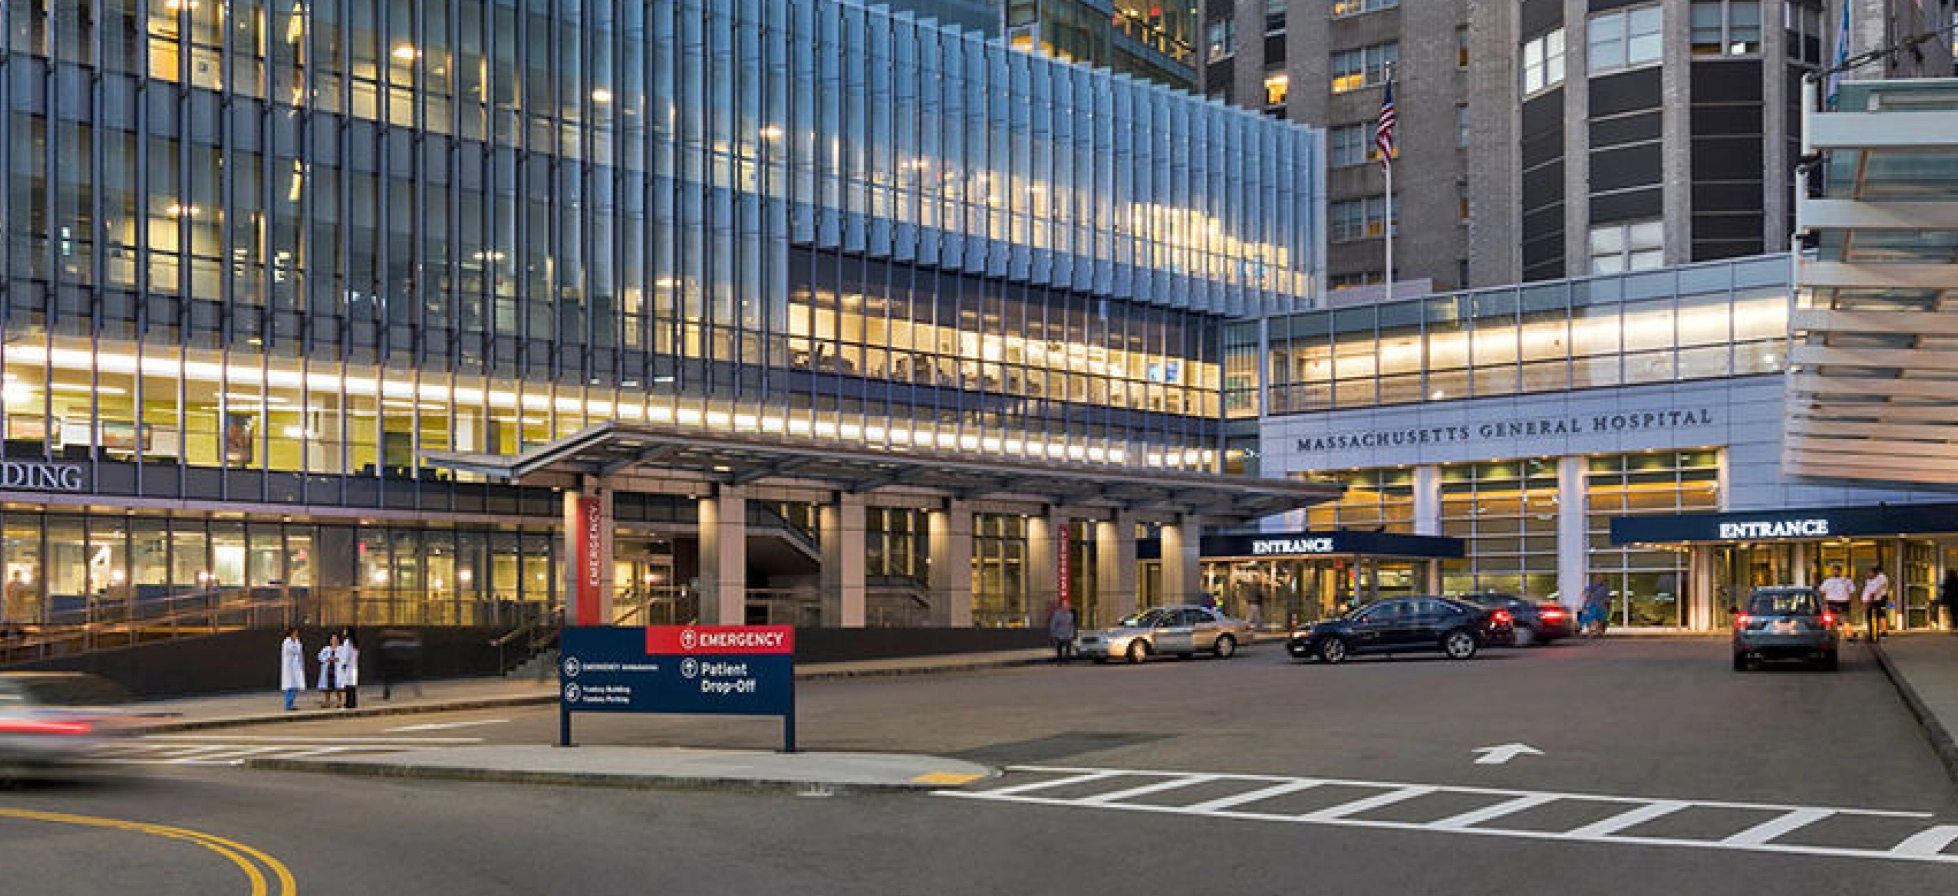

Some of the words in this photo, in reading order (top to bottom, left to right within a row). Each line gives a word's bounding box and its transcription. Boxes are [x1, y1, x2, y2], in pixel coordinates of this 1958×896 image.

[1297, 425, 1470, 451] MASSACHUSETTS
[1480, 417, 1583, 438] GENERAL
[1592, 408, 1712, 432] HOSPITAL
[1719, 519, 1829, 539] ENTRANCE
[589, 502, 600, 587] EMERGENCY
[1253, 537, 1334, 555] ENTRANCE
[700, 632, 784, 647] EMERGENCY
[701, 662, 748, 677] Patient
[701, 678, 757, 695] Drop-Off
